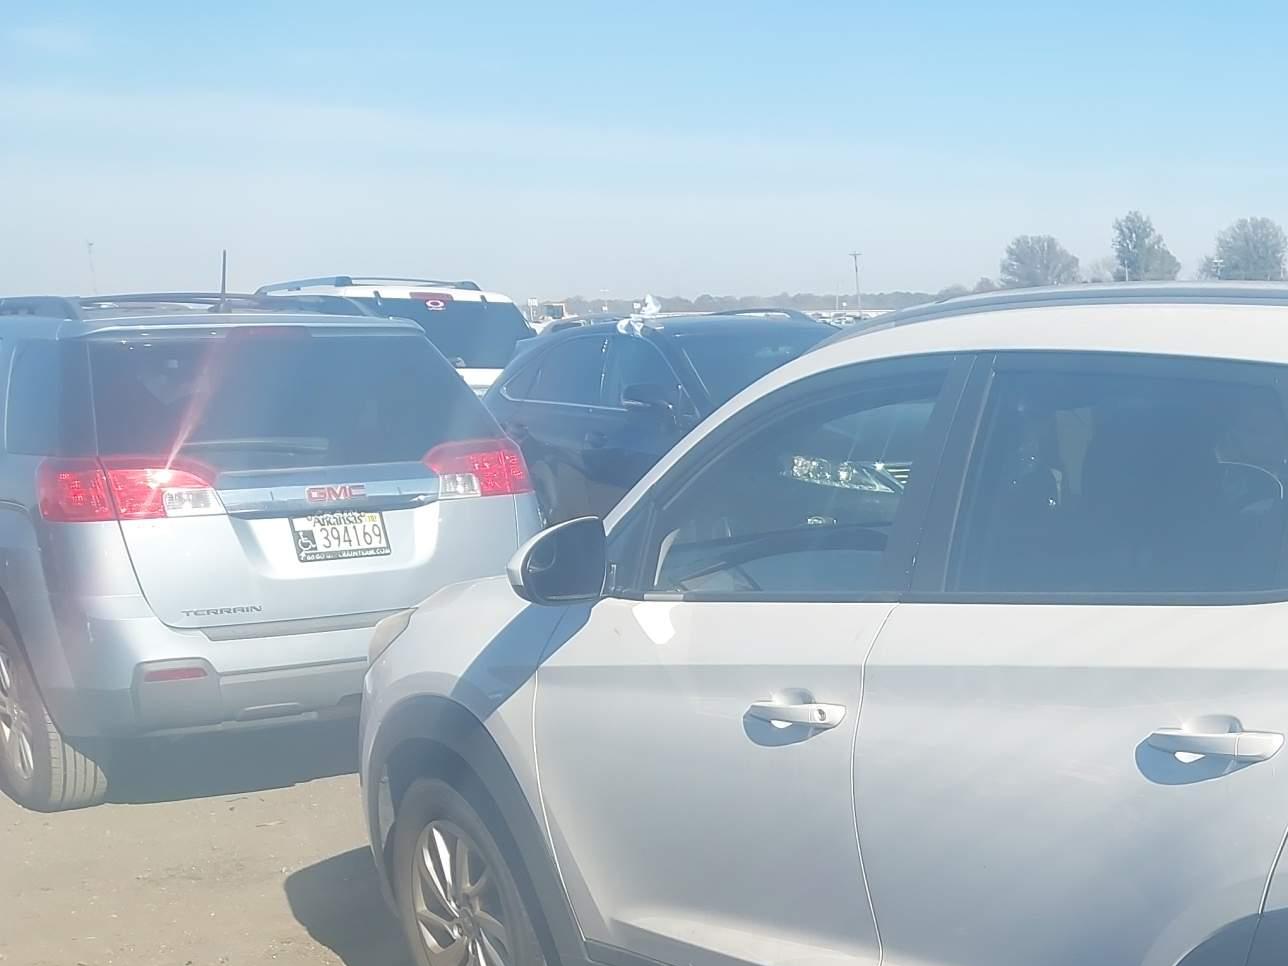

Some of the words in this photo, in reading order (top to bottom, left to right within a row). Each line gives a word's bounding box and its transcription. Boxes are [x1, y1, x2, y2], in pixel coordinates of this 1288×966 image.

[306, 483, 367, 503] GMC
[320, 524, 382, 549] 394169
[180, 606, 263, 617] TERRAIN
